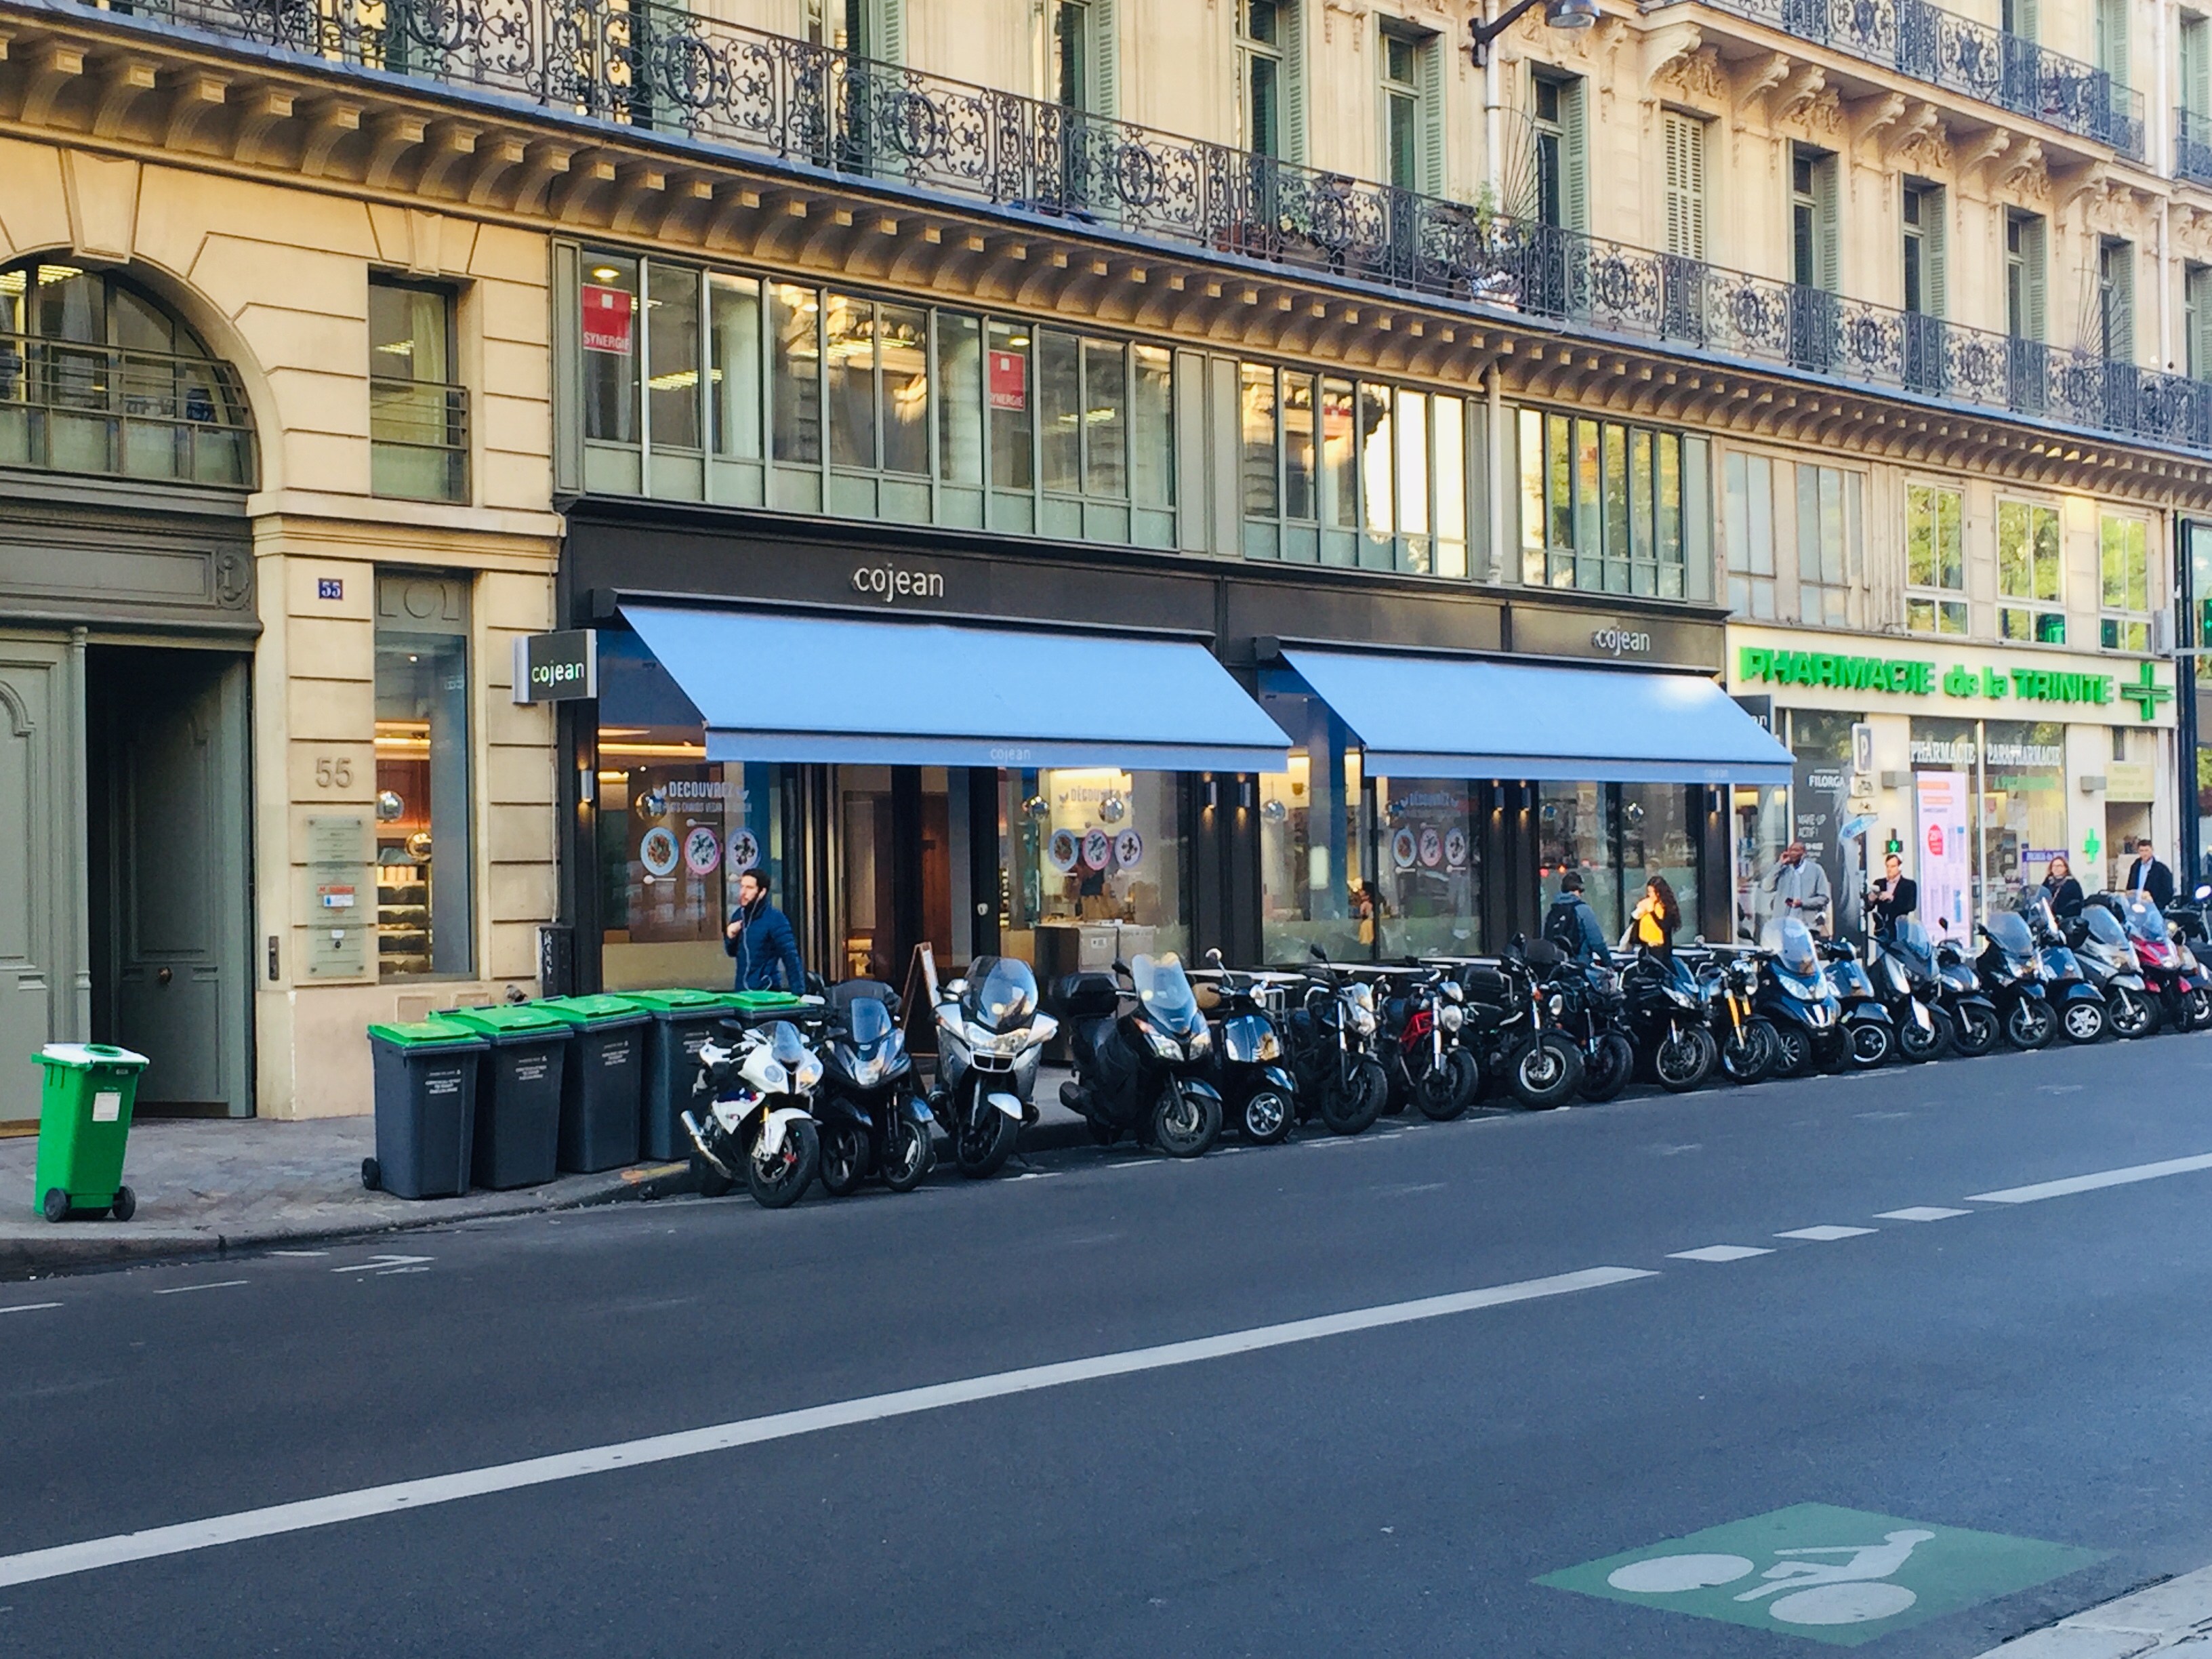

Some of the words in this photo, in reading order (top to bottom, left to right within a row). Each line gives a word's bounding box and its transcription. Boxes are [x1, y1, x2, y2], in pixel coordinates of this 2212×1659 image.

[583, 331, 630, 350] SYNERGIE
[989, 393, 1023, 407] YNERGIE
[321, 581, 341, 597] 55
[853, 562, 944, 602] cojean
[1594, 625, 1650, 656] cojean
[531, 659, 585, 687] cojean
[1740, 646, 1936, 695] PHARMACIE
[1944, 664, 1979, 697] de
[1982, 665, 2008, 699] la
[2011, 668, 2114, 704] TRINITE
[990, 747, 1031, 764] cojean
[1860, 735, 1868, 764] P
[1910, 741, 1976, 764] PHARMACIE
[316, 757, 354, 788] 55
[1808, 775, 1845, 787] FILORGA
